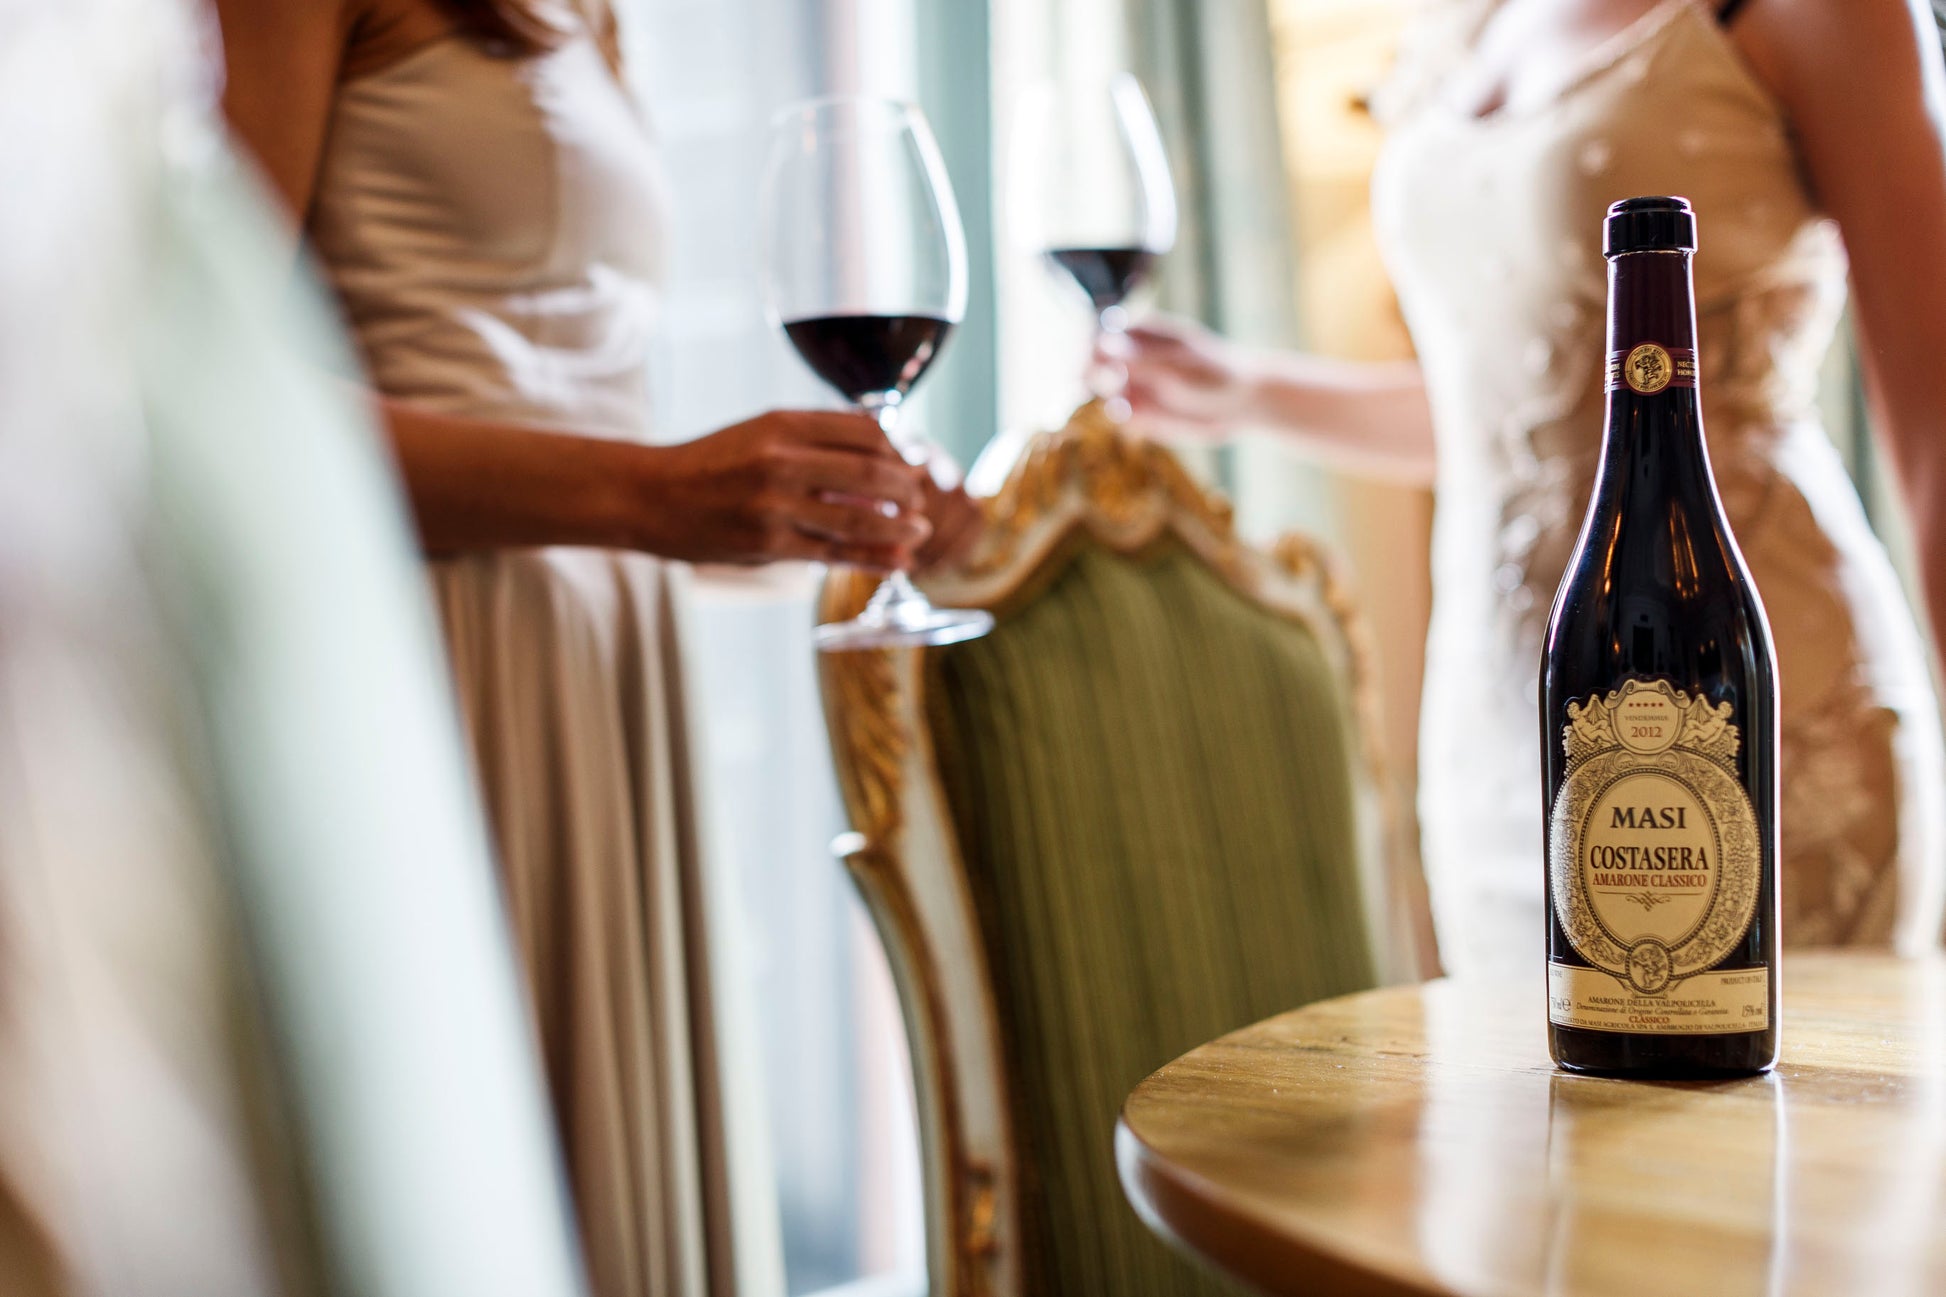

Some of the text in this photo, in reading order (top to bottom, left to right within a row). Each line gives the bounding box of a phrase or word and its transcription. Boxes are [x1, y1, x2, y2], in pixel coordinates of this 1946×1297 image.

[1631, 726, 1662, 738] 2012
[1610, 806, 1687, 829] MASI
[1590, 845, 1709, 871] COSTASERA
[1592, 873, 1708, 888] AMARONE CLASSICO
[1588, 996, 1716, 1008] AMARONE DELLA VALPOLICELLA
[1628, 1006, 1652, 1015] Origine
[1628, 1015, 1670, 1024] CLASSICO
